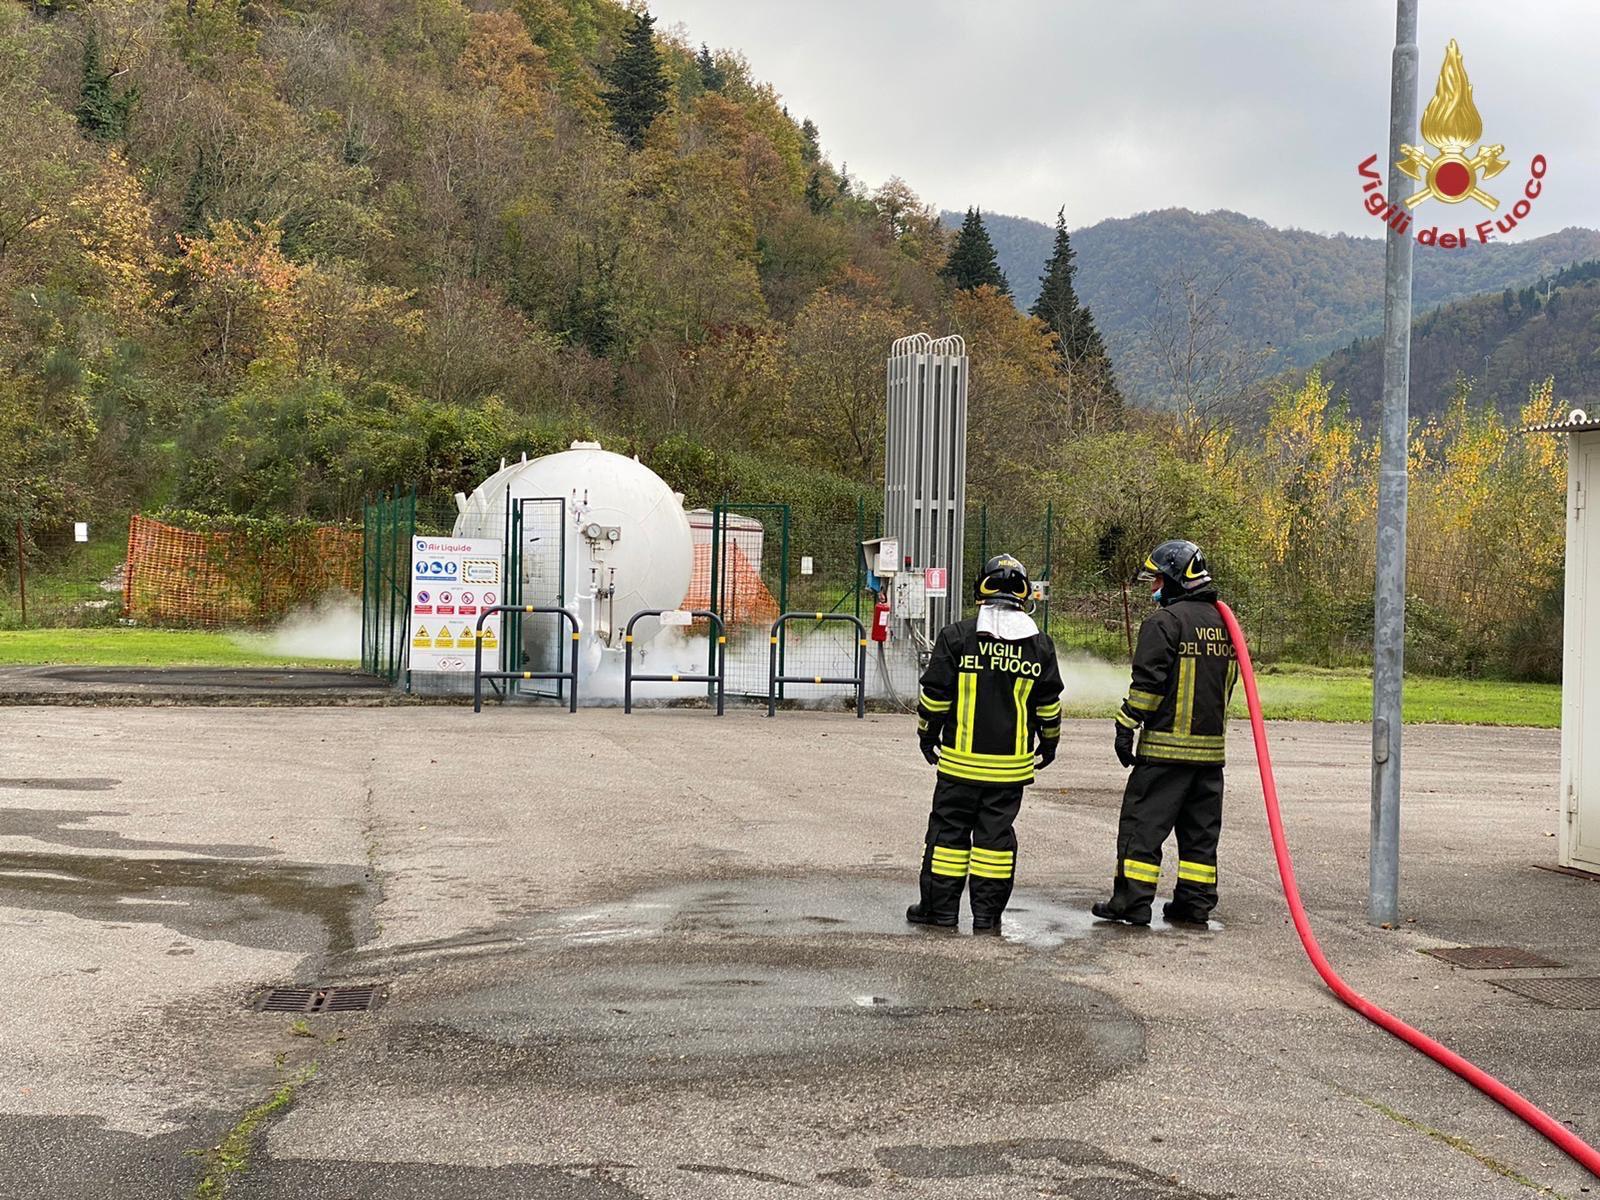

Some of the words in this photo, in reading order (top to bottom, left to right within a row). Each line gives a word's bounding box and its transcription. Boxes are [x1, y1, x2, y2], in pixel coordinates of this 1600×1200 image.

[441, 544, 472, 553] Liquide
[1195, 627, 1228, 641] VIGILI
[978, 641, 1022, 660] VIGILI
[1206, 643, 1237, 657] FUOC
[990, 656, 1042, 677] FUOCO
